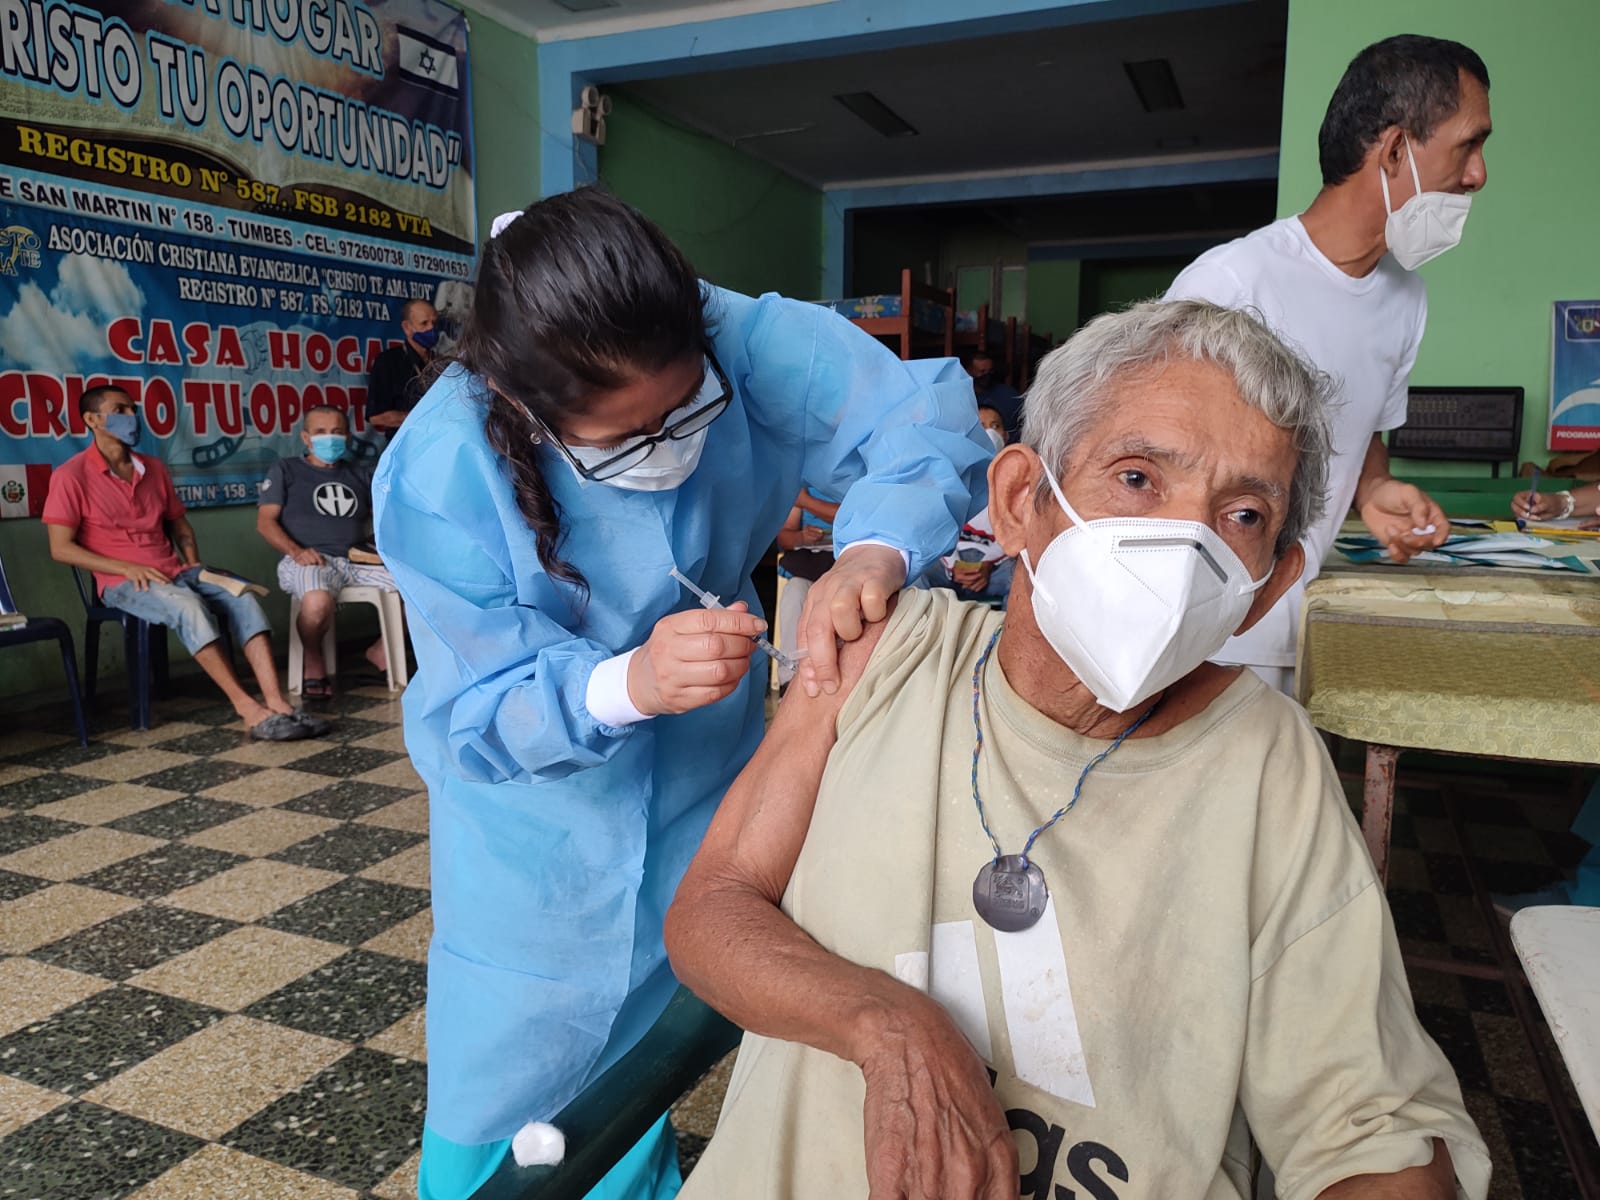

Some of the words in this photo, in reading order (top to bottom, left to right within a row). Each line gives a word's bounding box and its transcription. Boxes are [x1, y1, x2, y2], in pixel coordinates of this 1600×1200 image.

[150, 36, 206, 126] TU
[217, 60, 460, 190] OPORTUNIDAD"
[16, 125, 192, 187] REGISTRO
[237, 177, 288, 207] 587.
[293, 188, 338, 217] FSB
[345, 203, 391, 229] 2182
[396, 212, 432, 238] VTA
[20, 181, 67, 208] SAN
[72, 191, 151, 223] MARTIN
[183, 211, 213, 233] 158
[228, 219, 292, 247] TUMBES
[305, 236, 336, 255] CEL:
[339, 240, 404, 267] 972600738
[413, 254, 469, 278] 972901633
[48, 224, 155, 264] ASOCIACIÓN
[159, 242, 237, 276] CRISTIANA
[240, 254, 320, 287] EVANGELICA
[370, 276, 384, 295] TE
[386, 280, 408, 300] AMA
[178, 277, 257, 307] REGISTRO
[280, 290, 309, 313] 587.
[312, 293, 332, 316] FS.
[335, 297, 363, 319] 2182
[365, 301, 390, 322] VTA
[106, 316, 248, 368] CASA
[267, 330, 405, 375] HOGA
[0, 370, 177, 438] CRIO
[182, 379, 246, 437] TU
[175, 485, 202, 501] TIN
[224, 483, 246, 498] 158
